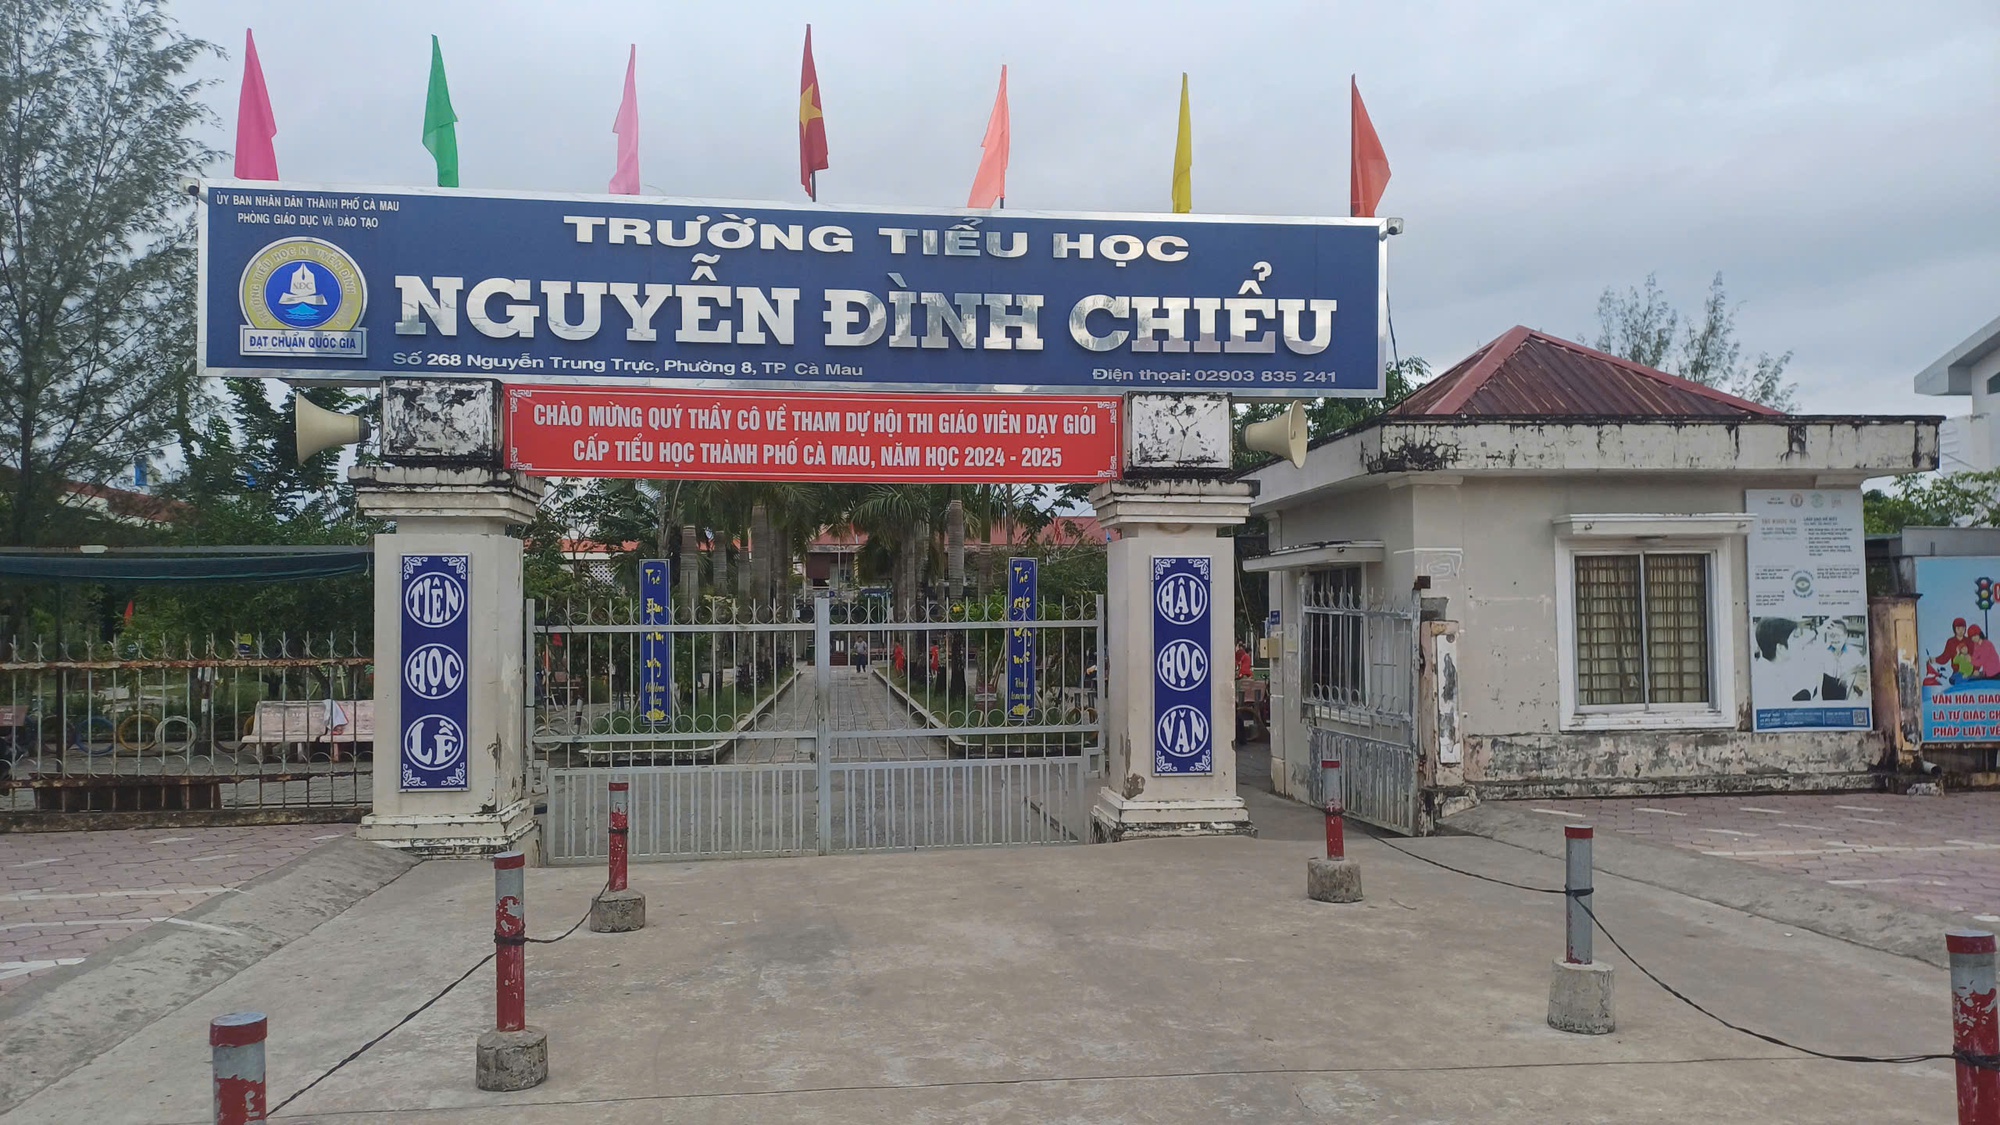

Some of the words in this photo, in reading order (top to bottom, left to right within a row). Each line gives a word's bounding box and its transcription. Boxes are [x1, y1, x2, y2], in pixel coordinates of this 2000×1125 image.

[216, 191, 229, 205] ỦY
[233, 195, 252, 206] BAN
[255, 194, 281, 207] NHÂN
[284, 194, 303, 208] DÂN
[307, 197, 338, 209] THÀNH
[341, 196, 360, 210] PHỐ
[363, 198, 376, 210] CÀ
[380, 200, 400, 212] MAU
[238, 212, 270, 224] PHÒNG
[274, 212, 296, 225] GIÁO
[300, 215, 318, 228] DỤC
[322, 215, 334, 226] VÀ
[338, 216, 357, 228] ĐÀO
[360, 217, 379, 230] TẠO
[299, 245, 344, 273] NUYỄN
[563, 213, 853, 253] TRƯỜNG
[878, 217, 1028, 258] TIỂU
[1052, 233, 1189, 268] HỌC
[395, 253, 800, 346] NGUYỄN
[823, 272, 1044, 350] ĐÌNH
[1068, 261, 1337, 355] CHIỂU
[250, 336, 269, 349] ĐẠT
[271, 332, 305, 348] CHUẨN
[308, 334, 337, 349] QUỐC
[339, 338, 356, 349] GIA
[393, 350, 422, 365] Số
[427, 353, 462, 366] 268
[467, 353, 544, 371] Nguyễn
[550, 356, 606, 373] Trung
[611, 358, 659, 374] Trực,
[664, 360, 736, 375] Phường
[741, 362, 757, 376] 8,
[762, 362, 786, 374] TP
[794, 362, 819, 375] Cà
[825, 363, 863, 376] Mau
[1092, 368, 1134, 382] Điện
[1194, 370, 1255, 382] 02903
[1261, 370, 1297, 382] 835
[1303, 371, 1336, 383] 241
[533, 401, 582, 426] CHÀO
[588, 402, 642, 428] MỪNG
[648, 404, 682, 432] QUÝ
[688, 402, 732, 430] THẦY
[737, 406, 760, 431] CÔ
[766, 403, 787, 431] VỀ
[792, 410, 840, 432] THAM
[846, 410, 872, 437] DỰ
[874, 408, 902, 438] HỘI
[907, 412, 933, 434] THI
[939, 410, 978, 434] GIÁO
[983, 410, 1021, 434] VIÊN
[1026, 414, 1058, 439] DẠY
[1063, 406, 1096, 435] GIỎI
[573, 432, 610, 462] CẤP
[615, 433, 653, 462] TIỂU
[659, 442, 694, 467] HỌC
[700, 438, 758, 464] THÀNH
[764, 438, 799, 465] PHỐ
[803, 440, 826, 466] CÀ
[832, 446, 876, 468] MAU,
[880, 442, 920, 467] NĂM
[925, 446, 960, 471] HỌC
[964, 446, 1006, 468] 2024
[1021, 447, 1062, 468] 2025
[410, 577, 460, 623] TIÊN
[1161, 576, 1203, 622] HẬU
[410, 648, 460, 696] HỌC
[1161, 643, 1204, 687] HỌC
[1932, 693, 1952, 704] VĂN
[1955, 692, 1975, 704] HÓA
[1933, 710, 1945, 720] LÀ
[1948, 710, 1961, 723] TỰ
[1963, 710, 1986, 720] GIÁC
[410, 719, 458, 765] LỄ
[1162, 709, 1204, 752] VĂN
[1933, 724, 1960, 737] PHÁP
[1963, 724, 1986, 738] LUẬT
